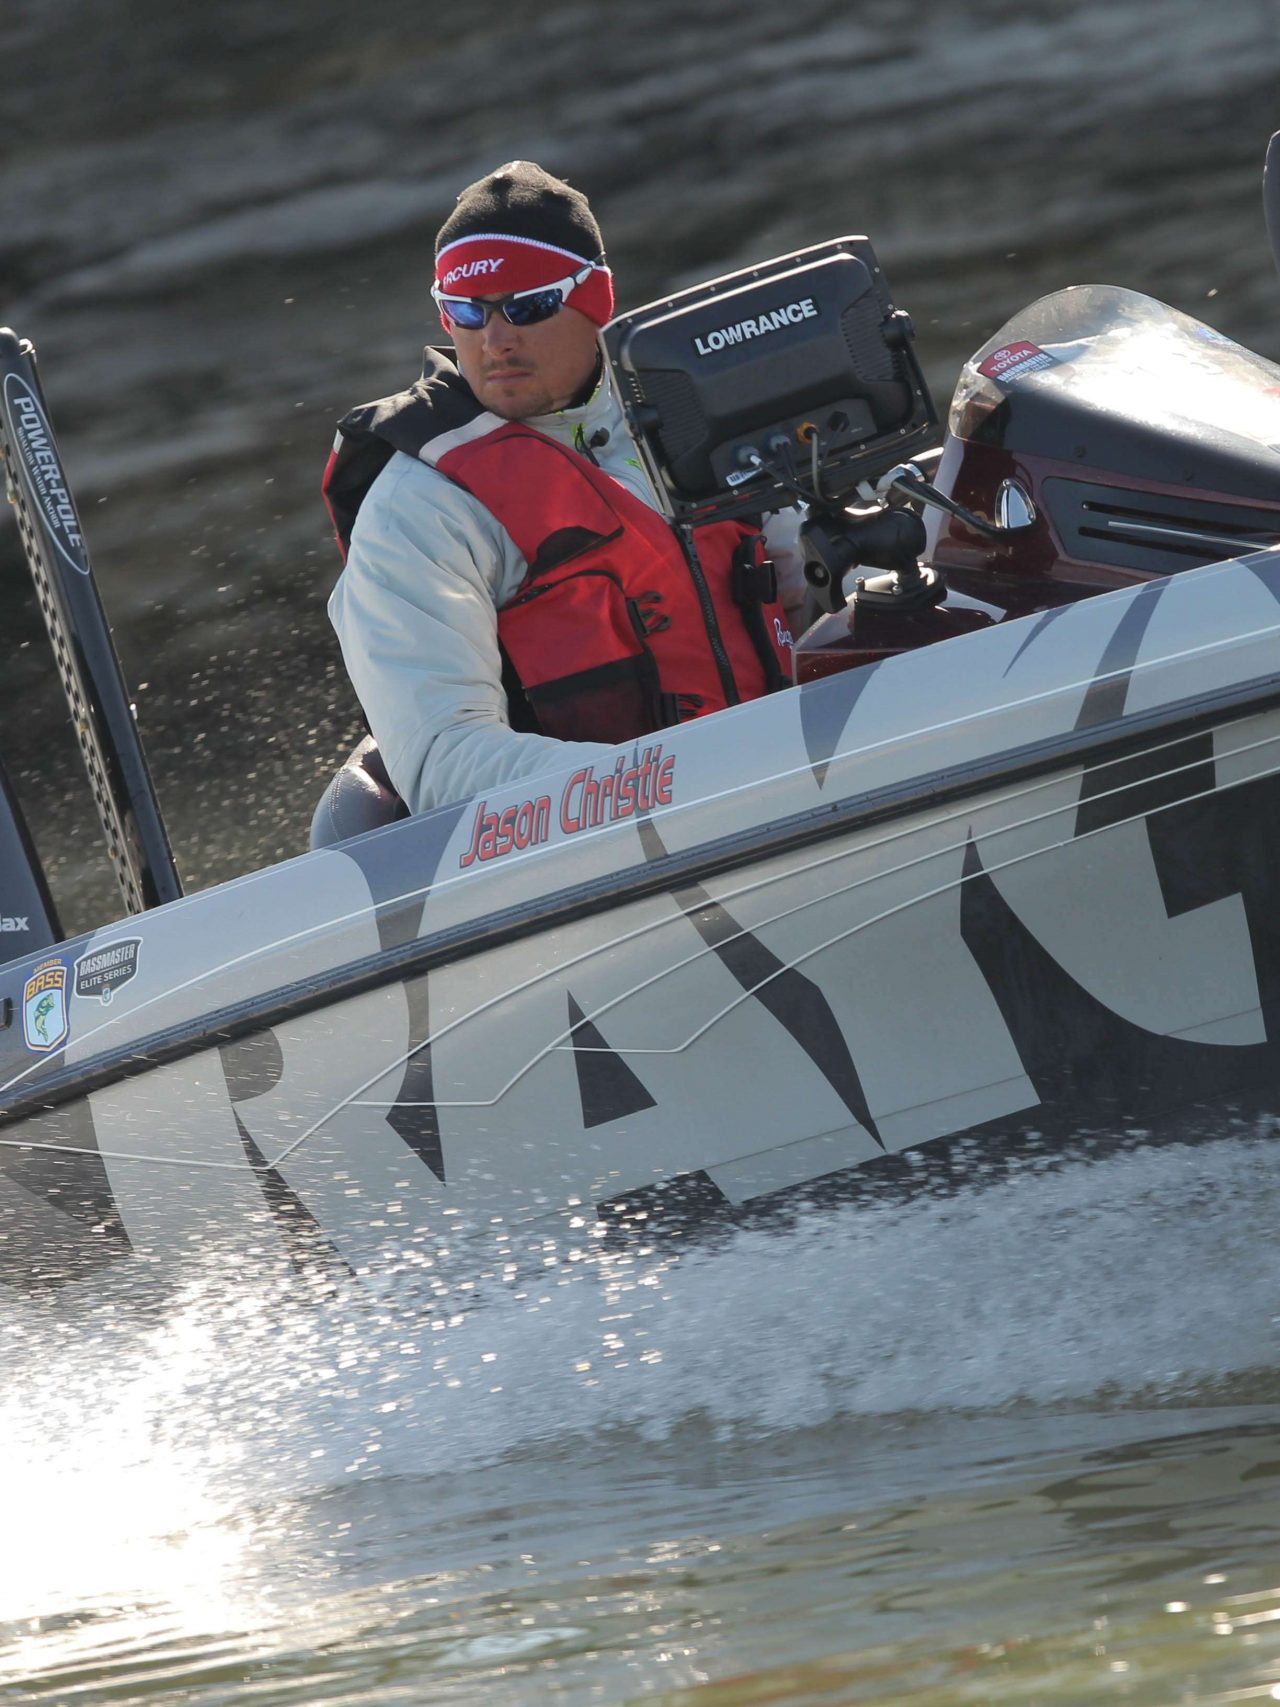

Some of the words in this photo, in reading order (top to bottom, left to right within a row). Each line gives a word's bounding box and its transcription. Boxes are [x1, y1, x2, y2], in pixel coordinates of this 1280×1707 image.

[694, 298, 818, 356] LOWRANCE
[989, 349, 1033, 372] TOYOTA
[14, 396, 83, 548] POWER-POLE
[459, 794, 551, 869] Jason
[559, 743, 677, 836] Christie
[0, 913, 30, 932] ax
[80, 943, 135, 976] BASSMASTER
[25, 971, 64, 1001] BASS
[80, 975, 102, 989] ELITE
[103, 965, 132, 981] SERIES
